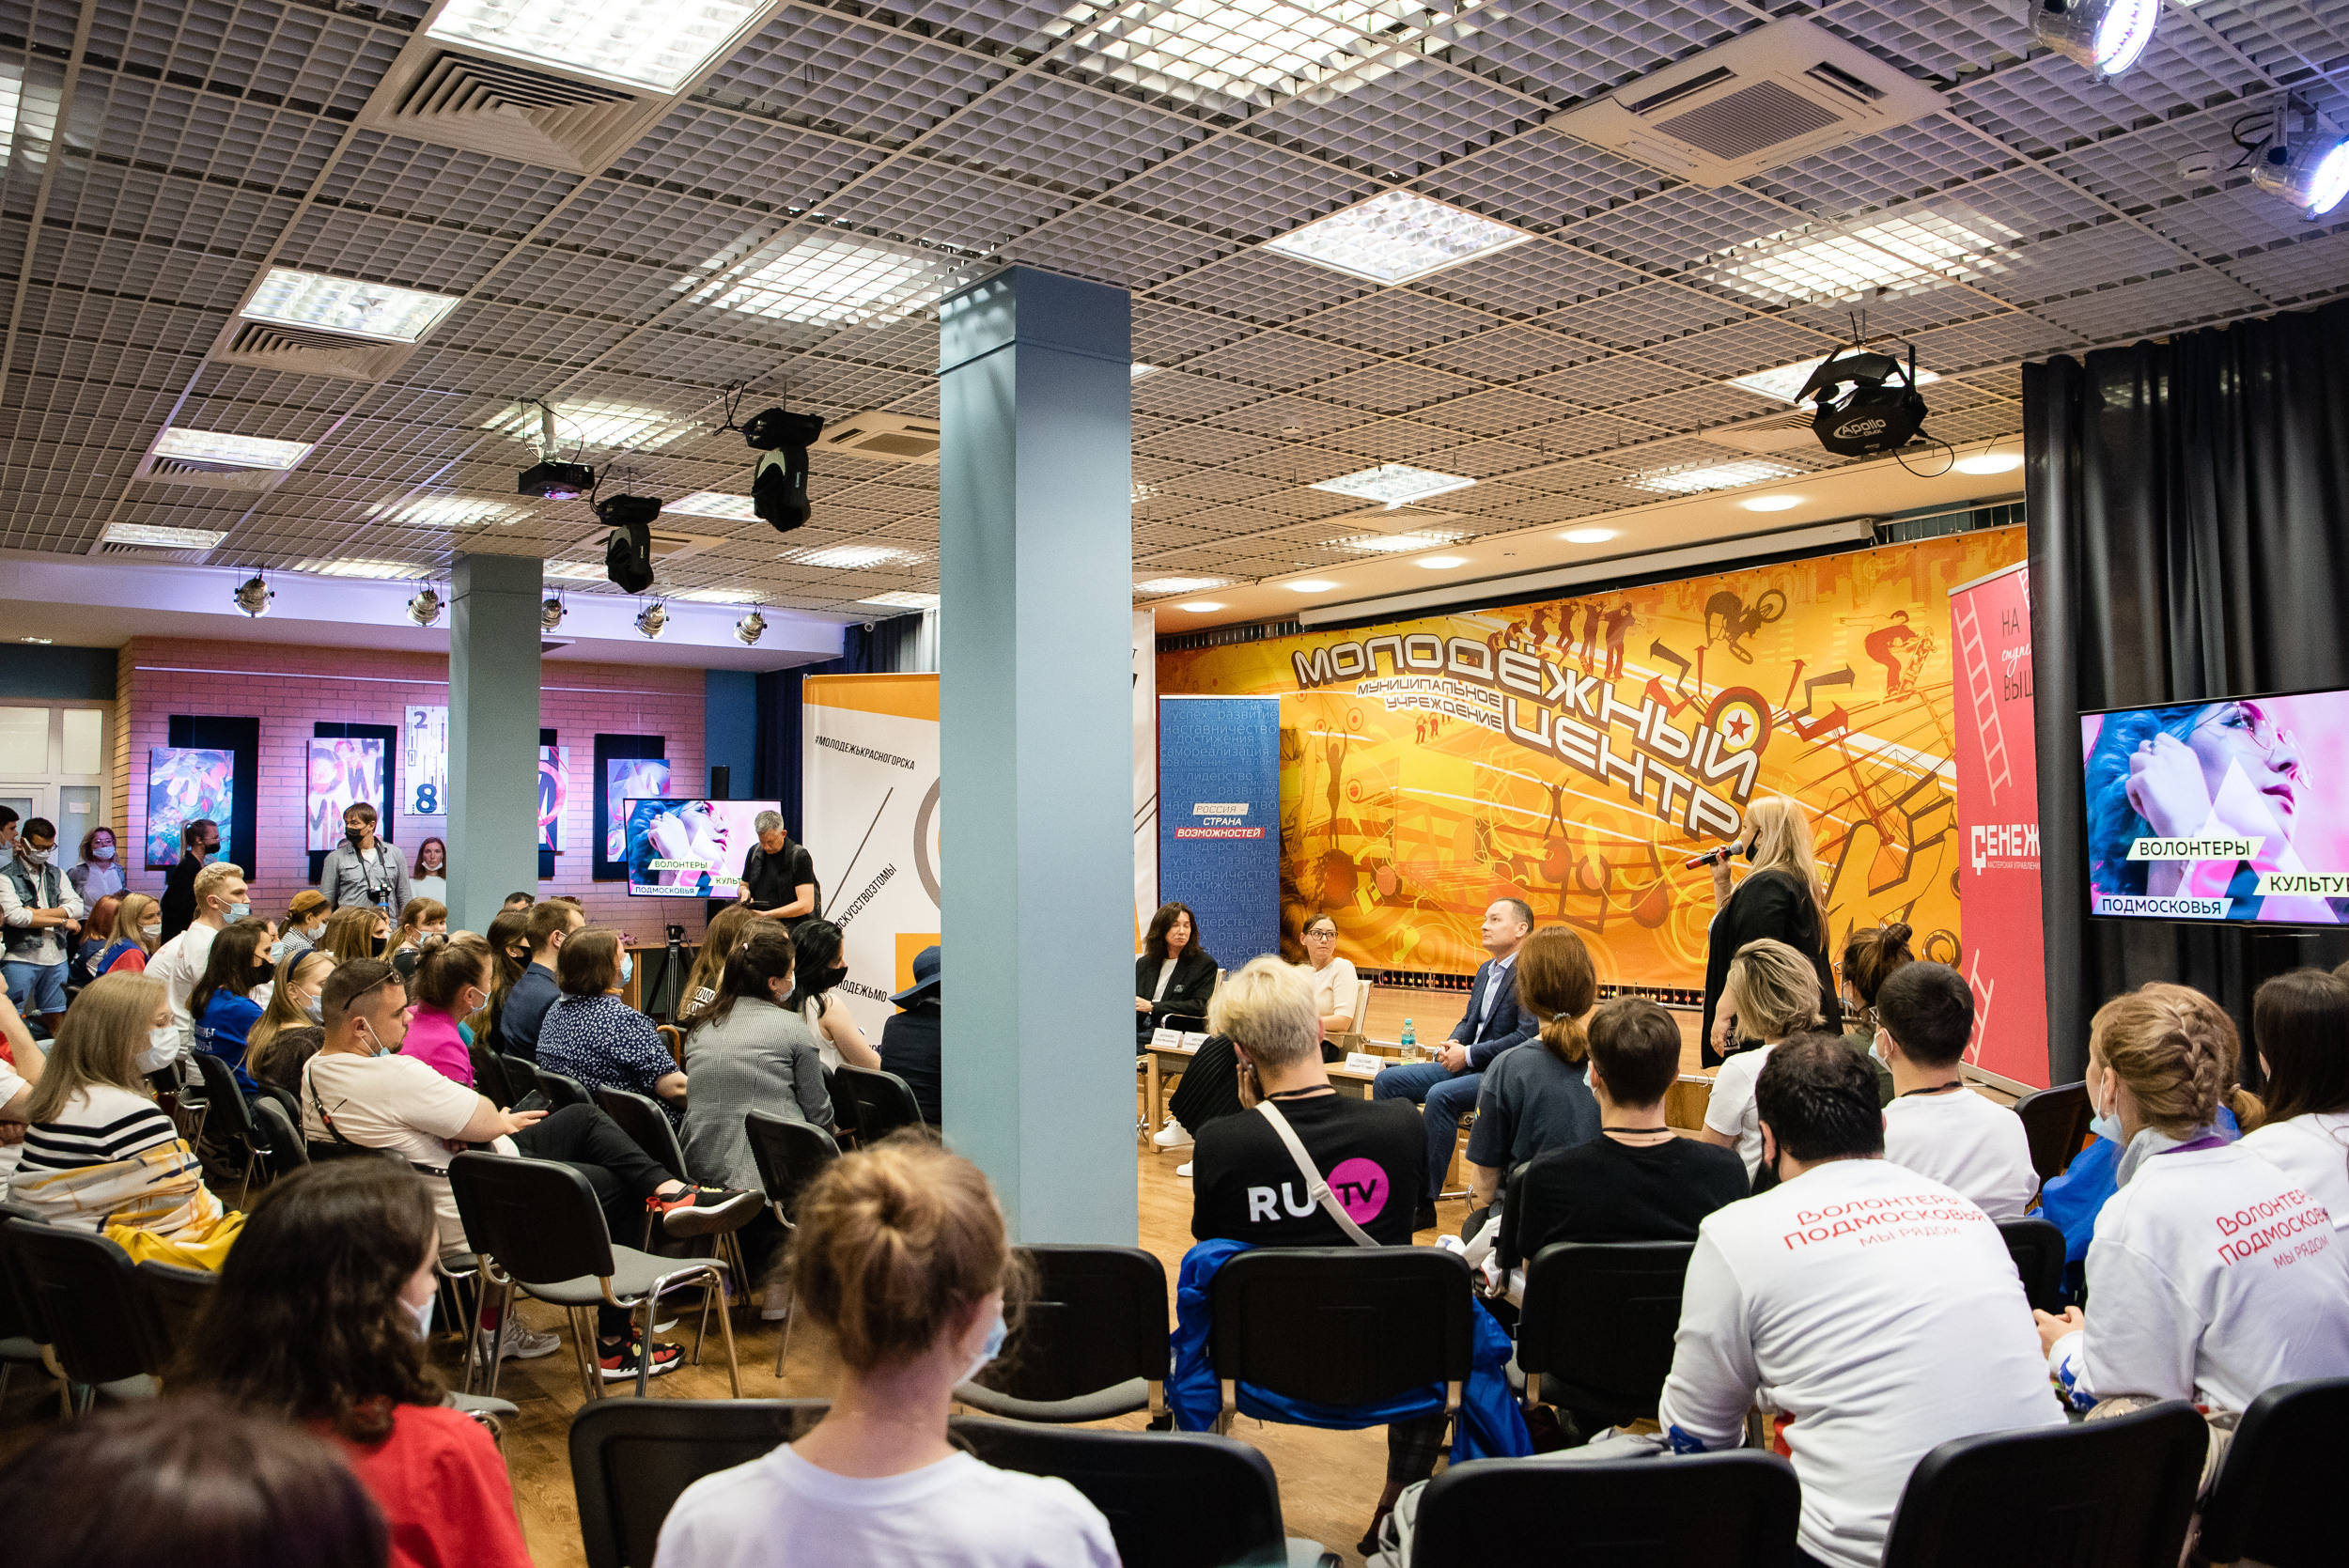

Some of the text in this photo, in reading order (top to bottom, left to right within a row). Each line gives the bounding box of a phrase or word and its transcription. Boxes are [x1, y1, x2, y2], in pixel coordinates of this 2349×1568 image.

[1842, 419, 1887, 436] Apollo
[2002, 608, 2019, 637] НА
[1357, 678, 1501, 708] МУНИЦИПАЛЬНОЕ
[1173, 711, 1208, 722] успех
[1218, 711, 1278, 722] развитие
[1387, 696, 1502, 729] УЧРЕЖДЕНИЕ
[413, 711, 428, 729] 2
[1163, 724, 1277, 735] наставничество
[1176, 735, 1254, 745] достижения
[815, 735, 915, 770] #МОЛОДЕЖЬКРАСНОГОРСКА
[1160, 749, 1269, 758] самореализация
[1240, 757, 1277, 766] талант
[1504, 695, 1743, 842] ЦЕНТР
[1187, 772, 1253, 782] лидерство
[1173, 787, 1208, 799] успех
[1218, 787, 1278, 797] развитие
[415, 784, 438, 814] 8
[1196, 805, 1237, 815] РОССИЯ
[1203, 817, 1242, 826] СТРАНА
[1177, 828, 1261, 837] ВОЗМОЖНОСТЕЙ
[1187, 842, 1253, 852] лидерство
[2139, 841, 2249, 856] ВОЛОНТЕРЫ
[655, 861, 708, 869] ВОЛОНТЕРЫ
[1173, 856, 1208, 867] успех
[1218, 856, 1278, 866] развитие
[1165, 870, 1277, 880] наставничество
[635, 886, 695, 894] ПОДМОСКОВЬЯ
[1176, 880, 1254, 891] достижения
[1160, 893, 1269, 904] самореализация
[1240, 903, 1277, 911] талант
[2102, 899, 2221, 915] ПОДМОСКОВЬЯ
[1219, 932, 1278, 941] развитие
[1247, 1178, 1377, 1222] RU TV
[1797, 1194, 1962, 1225] ВОЛОНТЕРЫ
[1783, 1209, 1987, 1250] ПОДМОСКОВЬЯ
[1859, 1225, 1961, 1247] МЫ РЯДОМ
[2273, 1234, 2330, 1269] МЫ РЯДОМ
